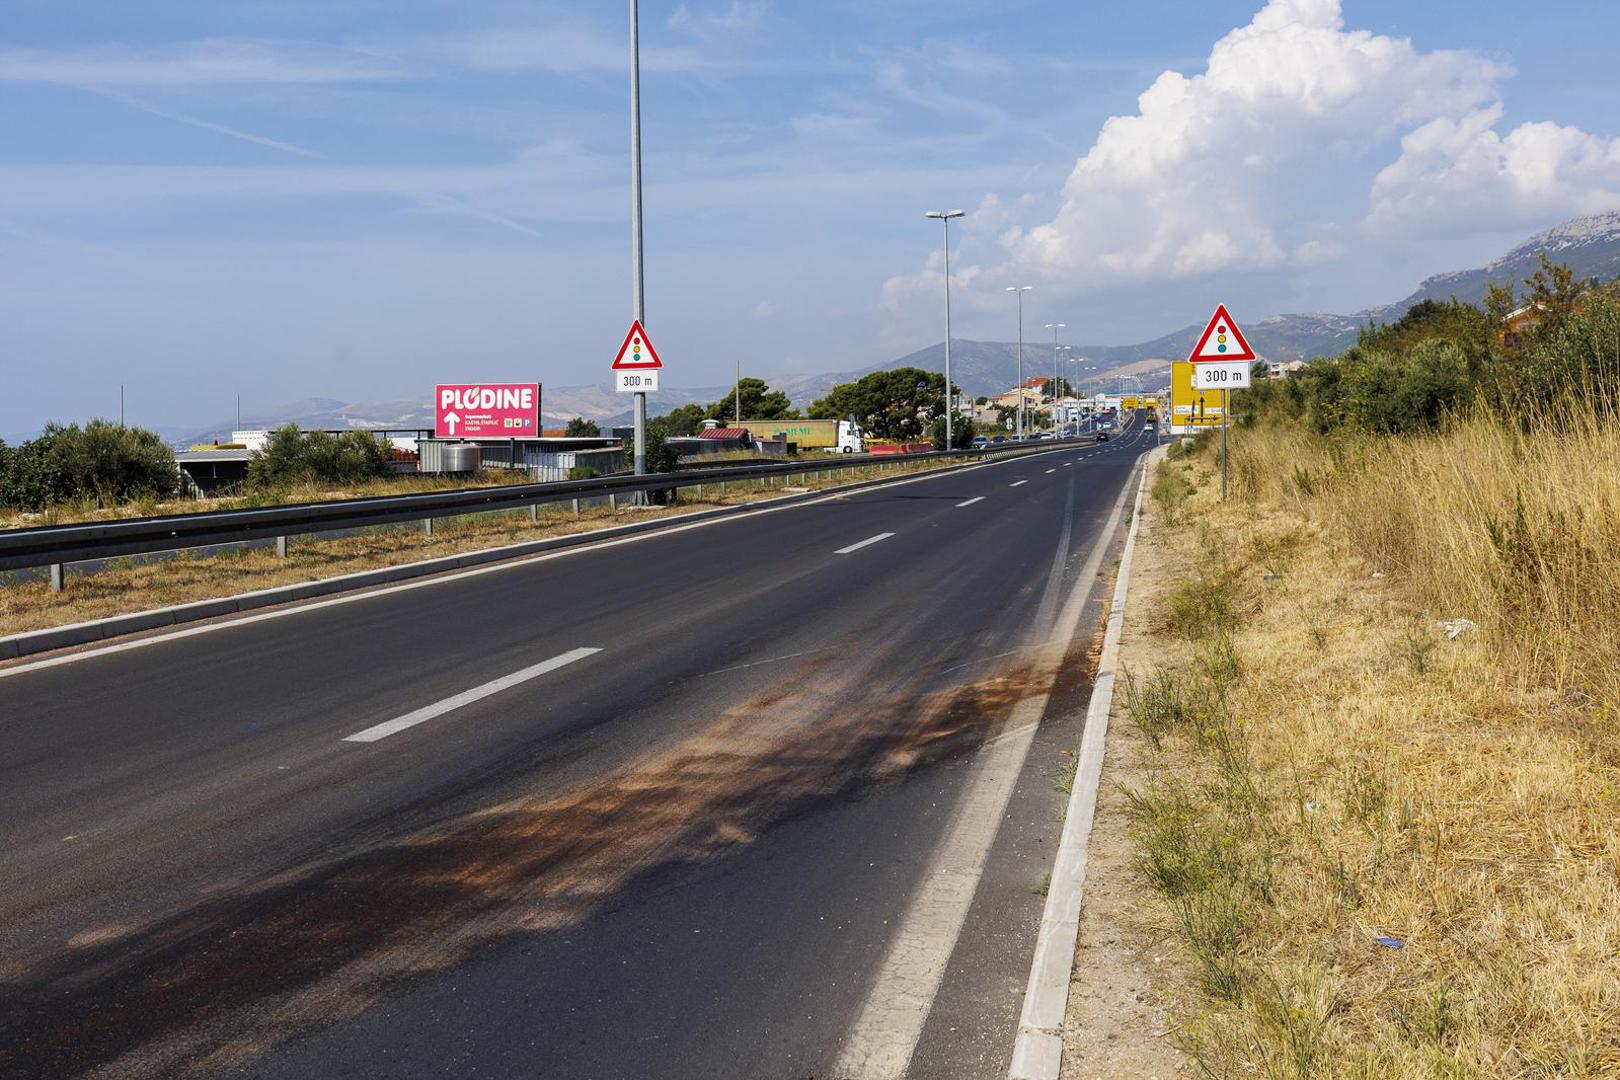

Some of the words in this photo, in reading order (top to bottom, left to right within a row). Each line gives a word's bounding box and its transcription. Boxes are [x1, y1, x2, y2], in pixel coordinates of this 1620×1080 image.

[623, 376, 640, 386] 300
[645, 378, 652, 386] m
[1205, 370, 1227, 382] 300
[1232, 372, 1242, 381] m
[441, 388, 533, 410] PLODINE
